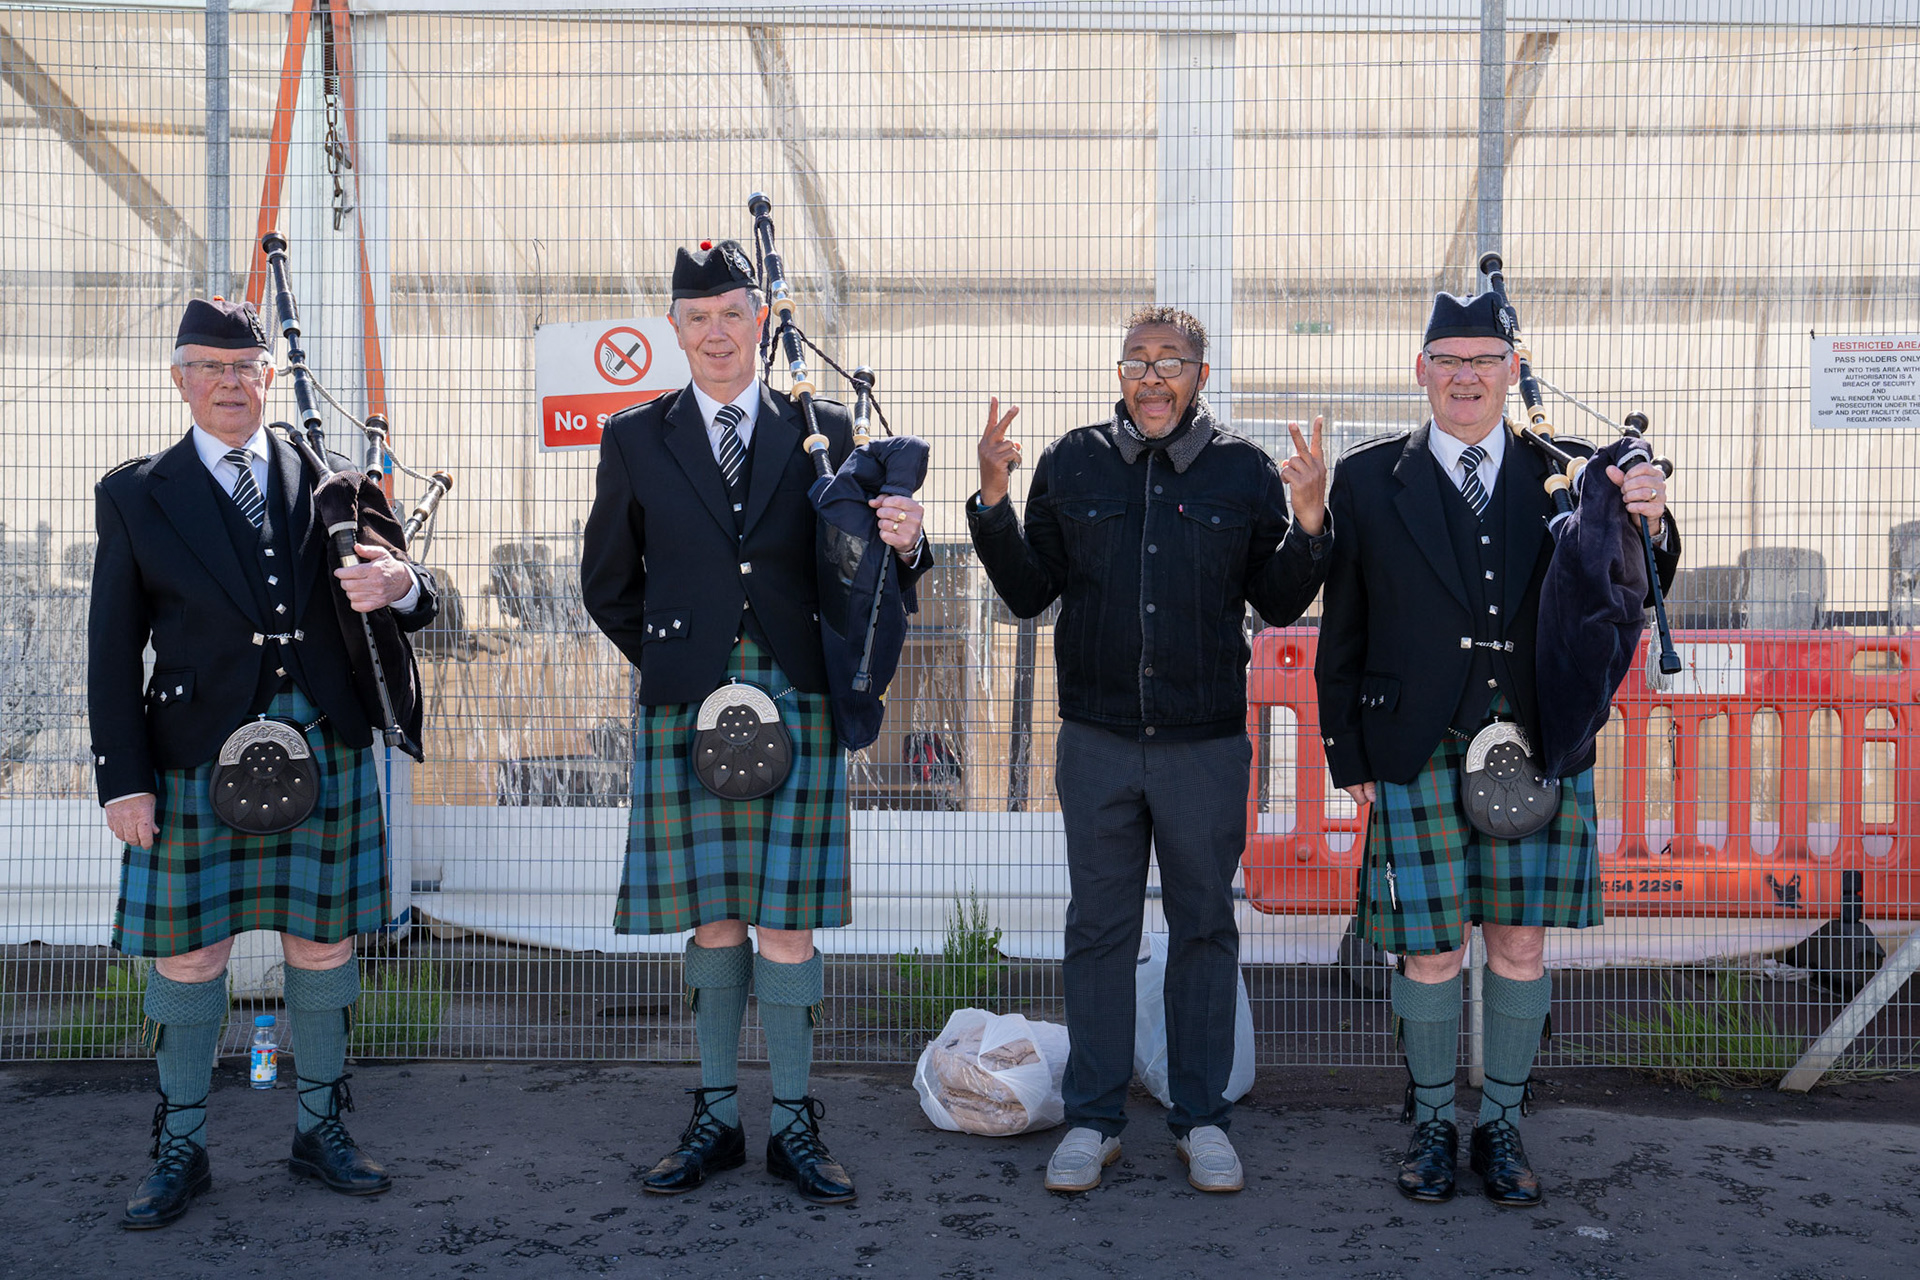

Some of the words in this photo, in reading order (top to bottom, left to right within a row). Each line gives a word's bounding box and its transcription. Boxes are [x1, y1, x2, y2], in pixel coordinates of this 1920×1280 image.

[1832, 341, 1894, 350] RESTRICTED
[1859, 355, 1898, 363] HOLDERS
[554, 410, 588, 431] No
